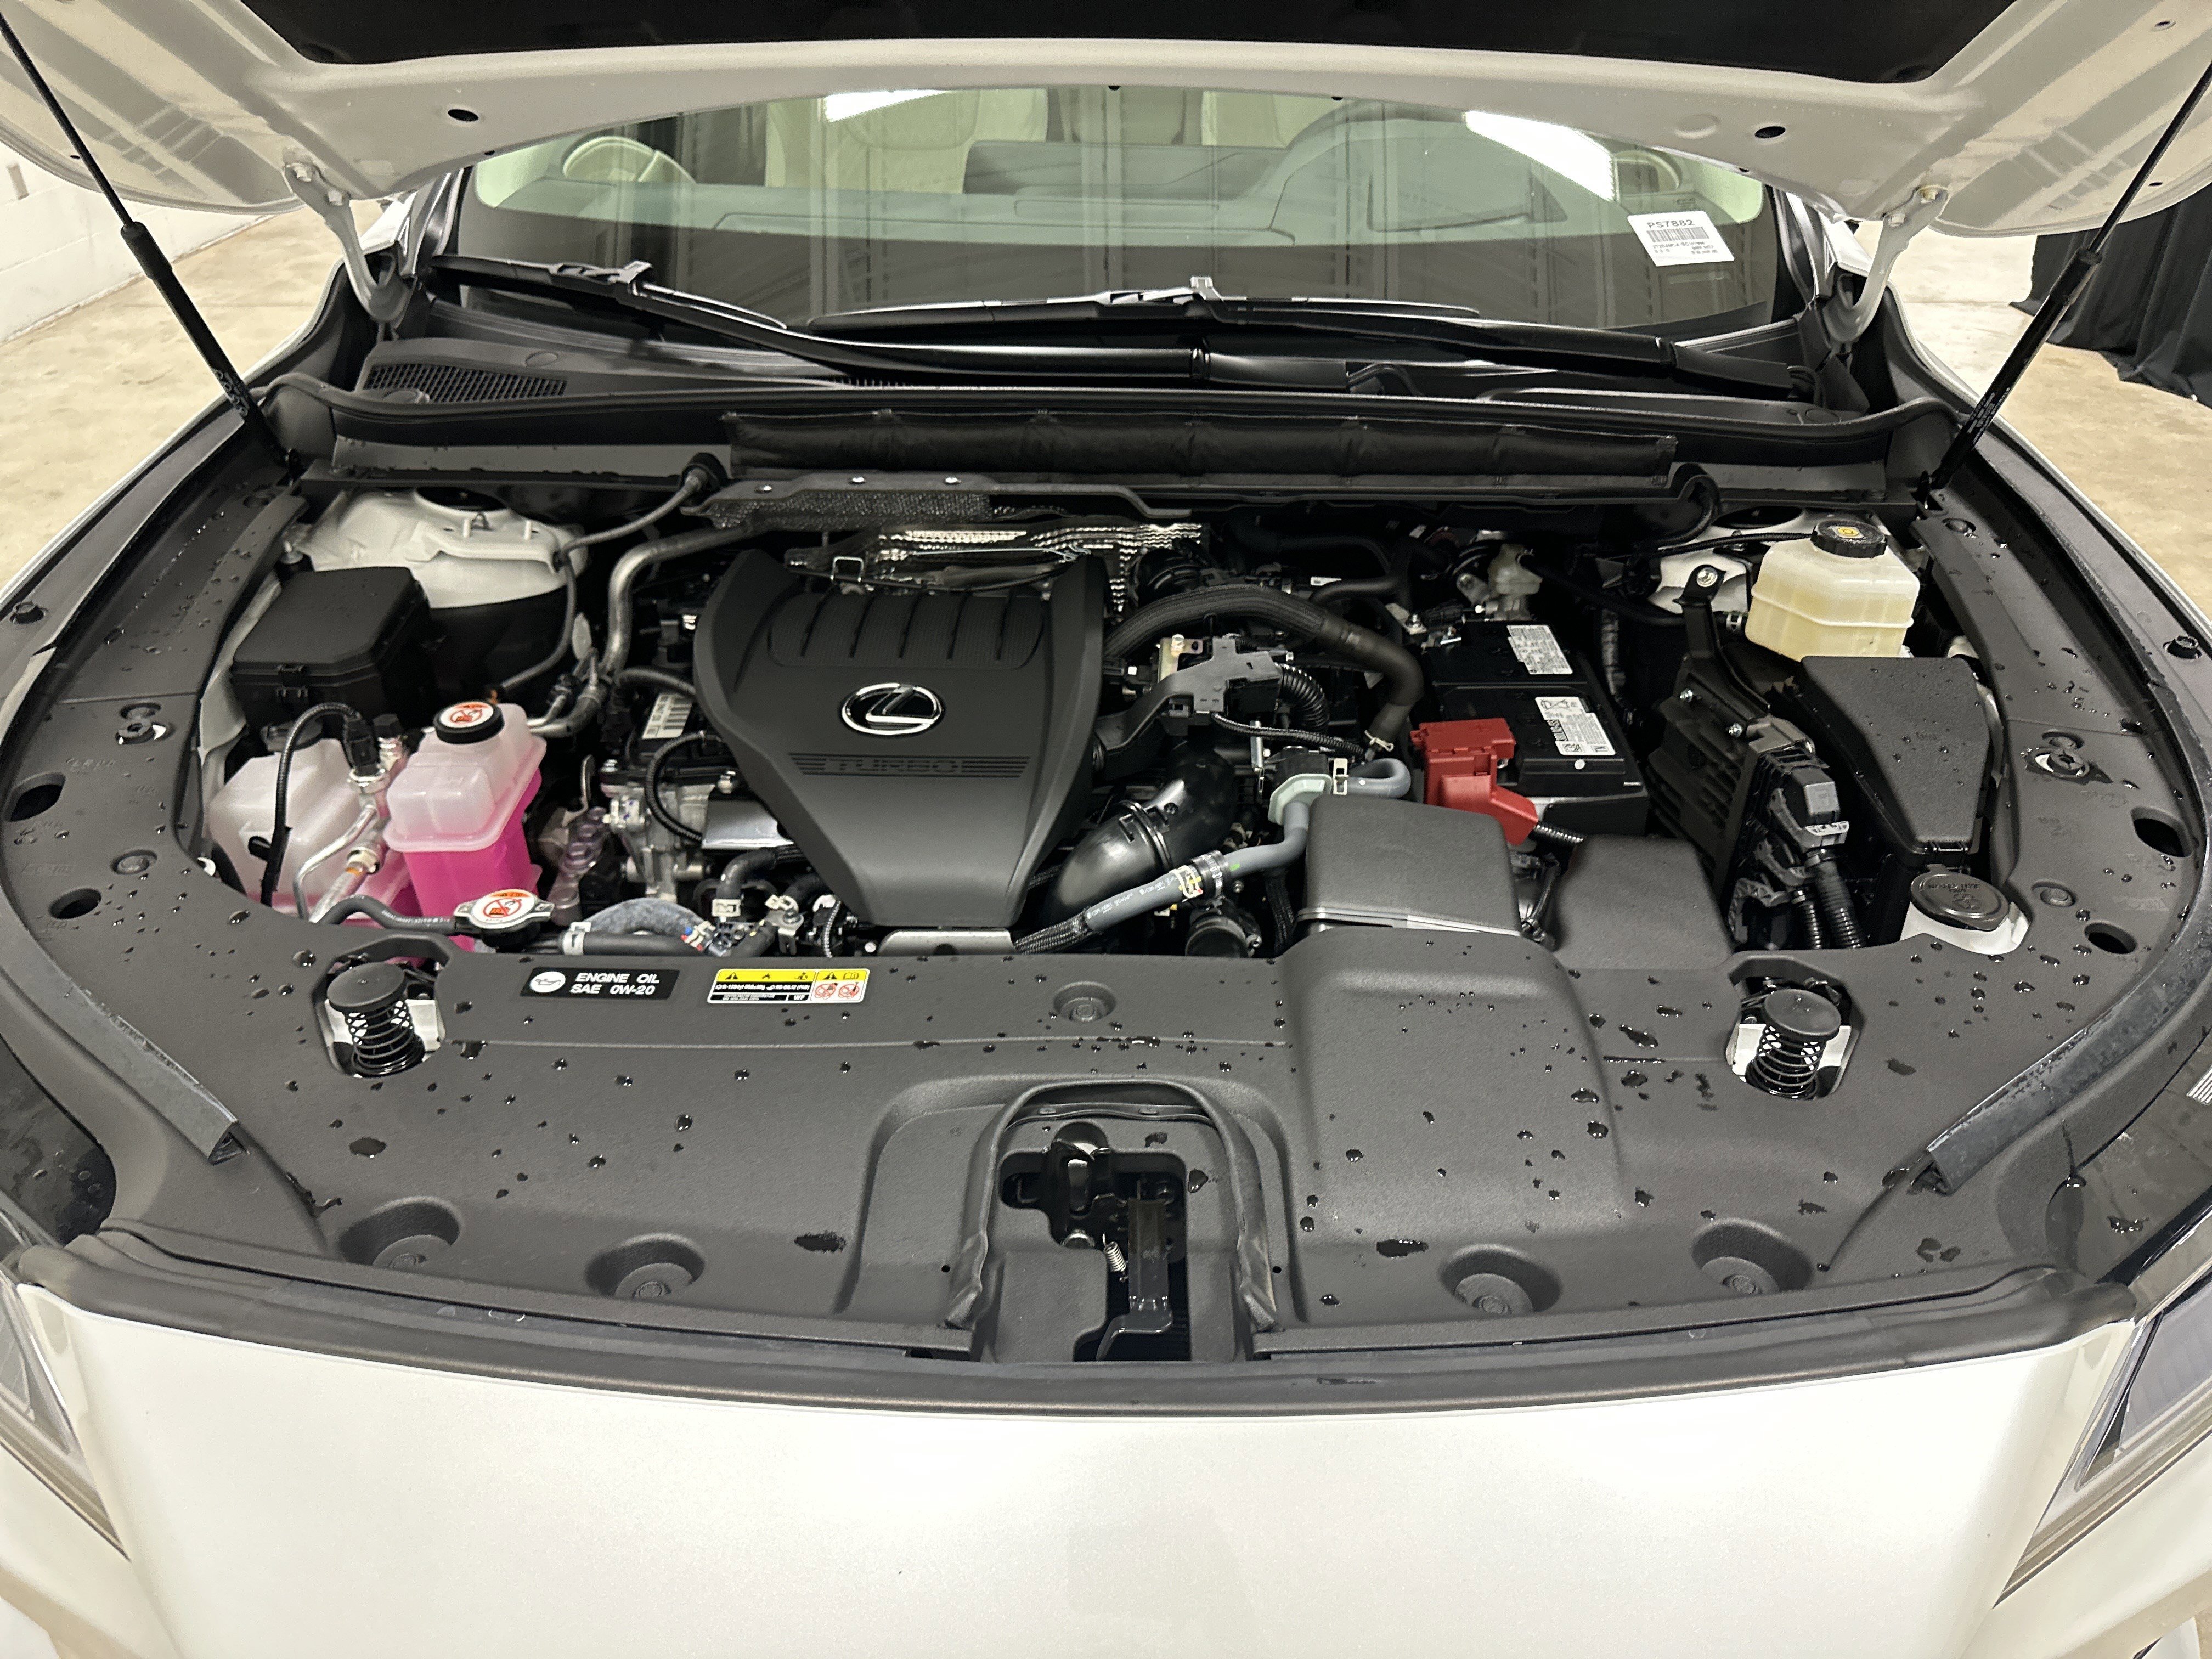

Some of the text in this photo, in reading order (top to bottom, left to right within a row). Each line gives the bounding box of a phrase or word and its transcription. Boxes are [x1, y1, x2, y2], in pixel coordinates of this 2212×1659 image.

[1647, 219, 1695, 229] PS7882
[829, 758, 958, 773] TURBO
[575, 972, 660, 984] ENGINE OIL
[570, 984, 656, 995] SAE 0W-20
